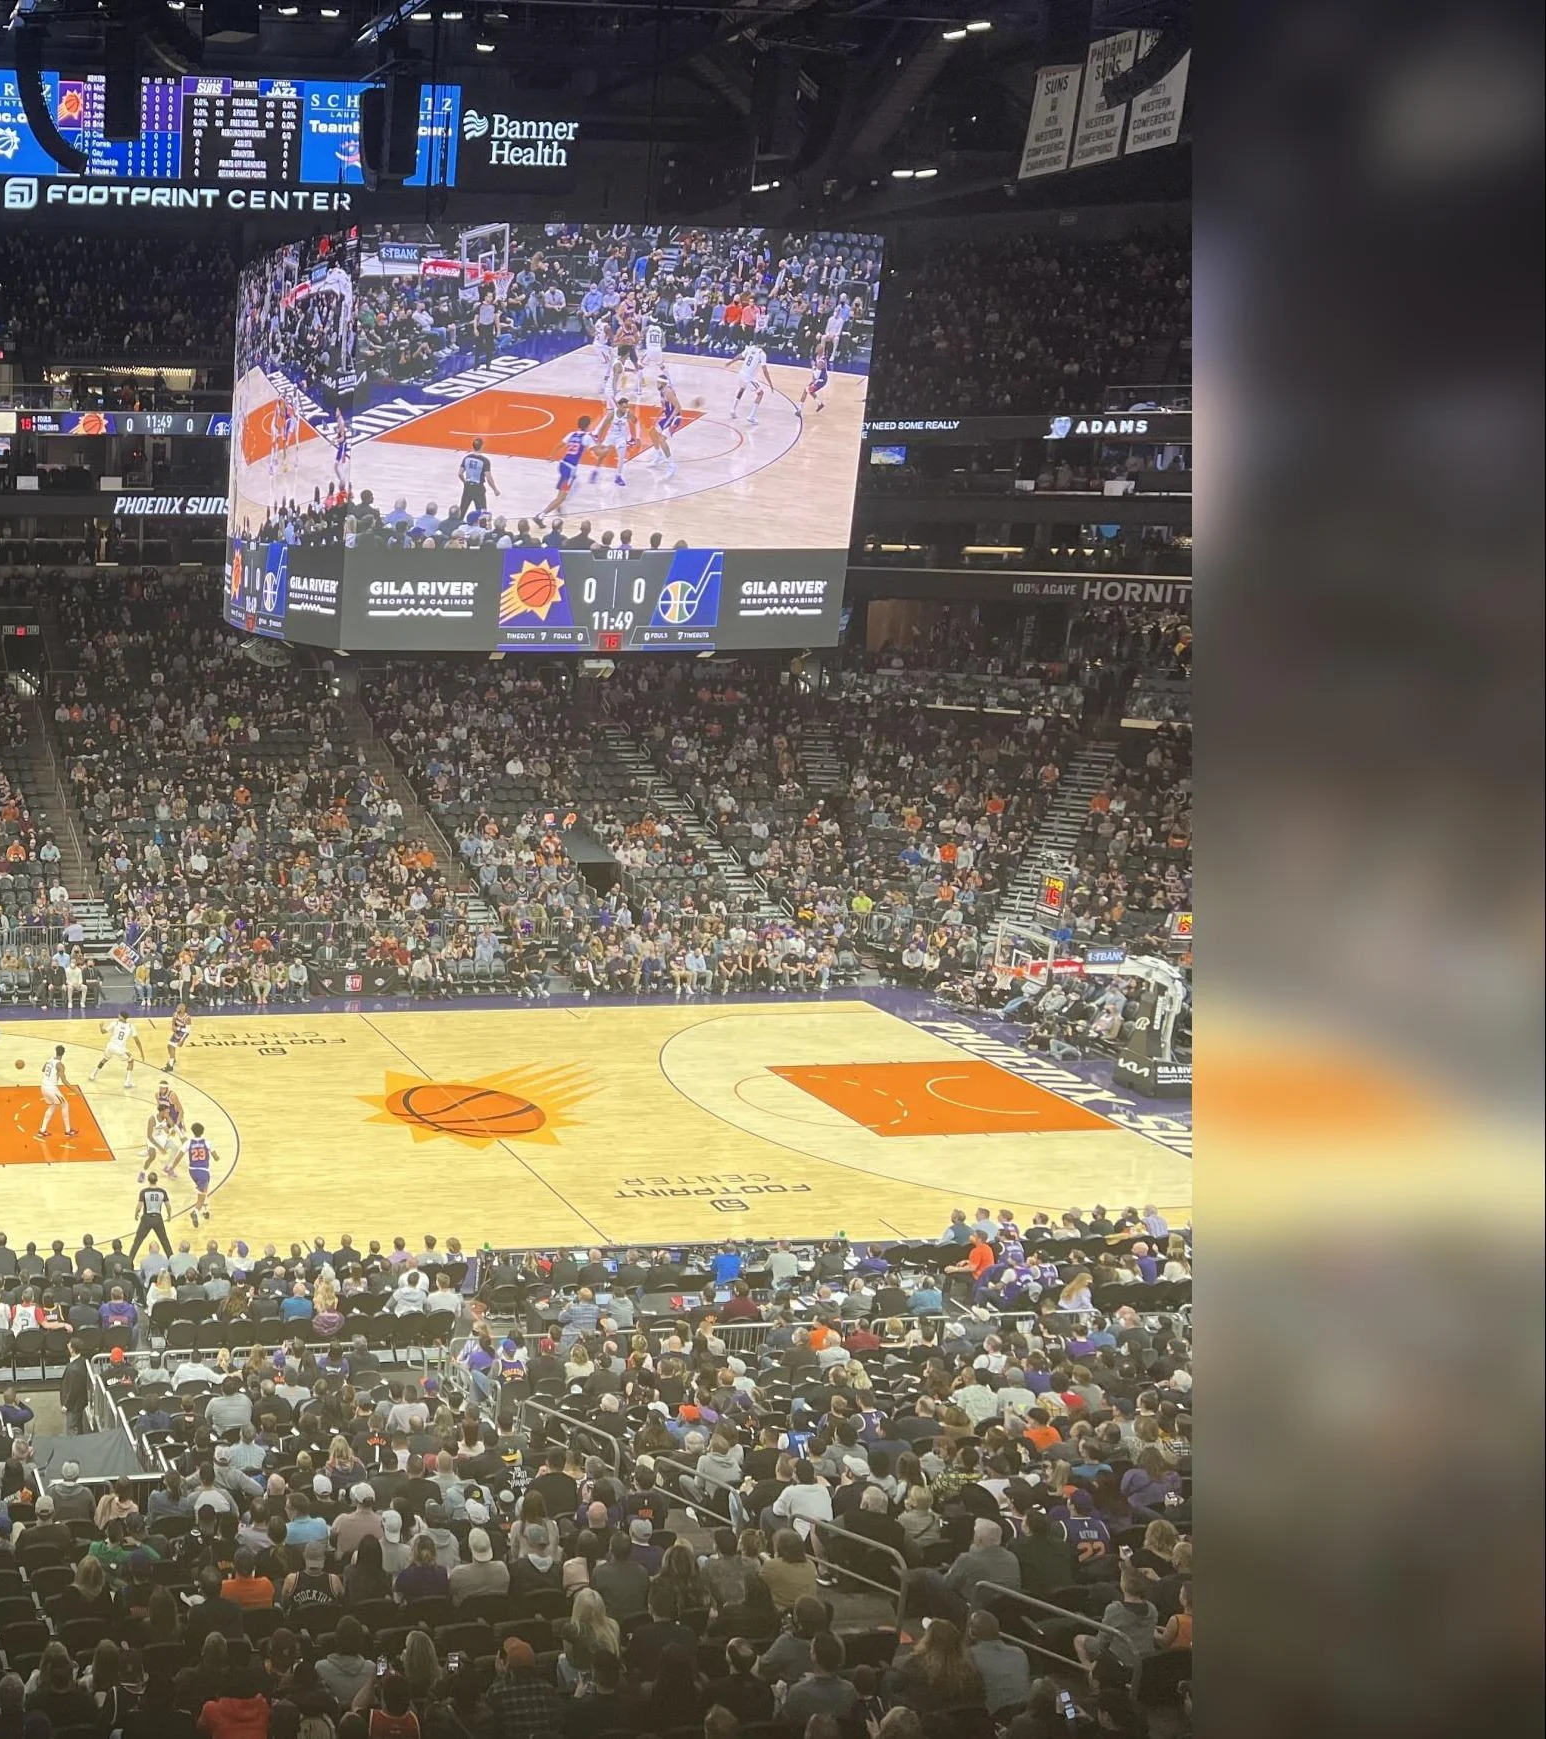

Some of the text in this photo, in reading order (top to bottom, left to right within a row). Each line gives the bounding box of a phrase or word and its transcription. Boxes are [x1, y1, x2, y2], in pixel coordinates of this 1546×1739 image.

[1090, 37, 1133, 63] PHOENIX
[1095, 60, 1122, 81] SUNS
[197, 83, 222, 94] SUNS
[266, 87, 296, 96] JAZZ
[1045, 75, 1069, 95] SUNS
[194, 98, 208, 106] 0.0%
[282, 101, 296, 109] 0.0%
[1141, 97, 1172, 113] WESTERN
[194, 108, 208, 116] 0.0%
[282, 111, 296, 119] 0.0%
[1133, 111, 1176, 130] CONFERENCE
[193, 118, 207, 126] 0.0%
[282, 121, 295, 129] 0.0%
[491, 115, 579, 141] Banner
[1085, 114, 1115, 129] WESTERN
[1078, 127, 1118, 146] CONFERENCE
[1132, 127, 1172, 145] CHAMPIONS
[490, 141, 567, 166] Health
[91, 159, 118, 167] Whiteside
[47, 186, 352, 211] FOOTPRINT CENTER
[21, 417, 31, 430] 15
[126, 418, 134, 432] 0
[145, 414, 172, 428] 11:49
[186, 418, 193, 432] 0
[872, 420, 960, 430] NEED SOME REALLY
[1076, 420, 1148, 434] ADAMS
[114, 496, 182, 514] PHOENIX
[607, 549, 623, 560] QTR
[290, 576, 337, 594] GILA RIVER
[369, 581, 475, 596] GILA RIVER
[583, 577, 597, 603] 0
[632, 577, 646, 604] 0
[741, 580, 825, 595] GILA RIVER
[289, 592, 336, 603] RESORTS CASINOS
[1012, 581, 1192, 604] 100% AGAVE HORNIT
[592, 611, 634, 630] 11:49
[506, 631, 584, 641] TIMEOUTS 7 FOULS 0
[644, 632, 650, 641] 0
[677, 631, 684, 640] 7
[1046, 889, 1062, 907] 15
[117, 1031, 125, 1042] 8
[187, 1038, 347, 1048] FOOTPRINT
[200, 1032, 320, 1040] CENTER
[911, 1020, 1137, 1105] PHOENIX
[1157, 1066, 1177, 1074] GILA
[191, 1147, 206, 1161] 23
[622, 1174, 770, 1186] CENTER
[614, 1184, 811, 1199] FOOTPRINT
[1076, 1541, 1105, 1561] 22
